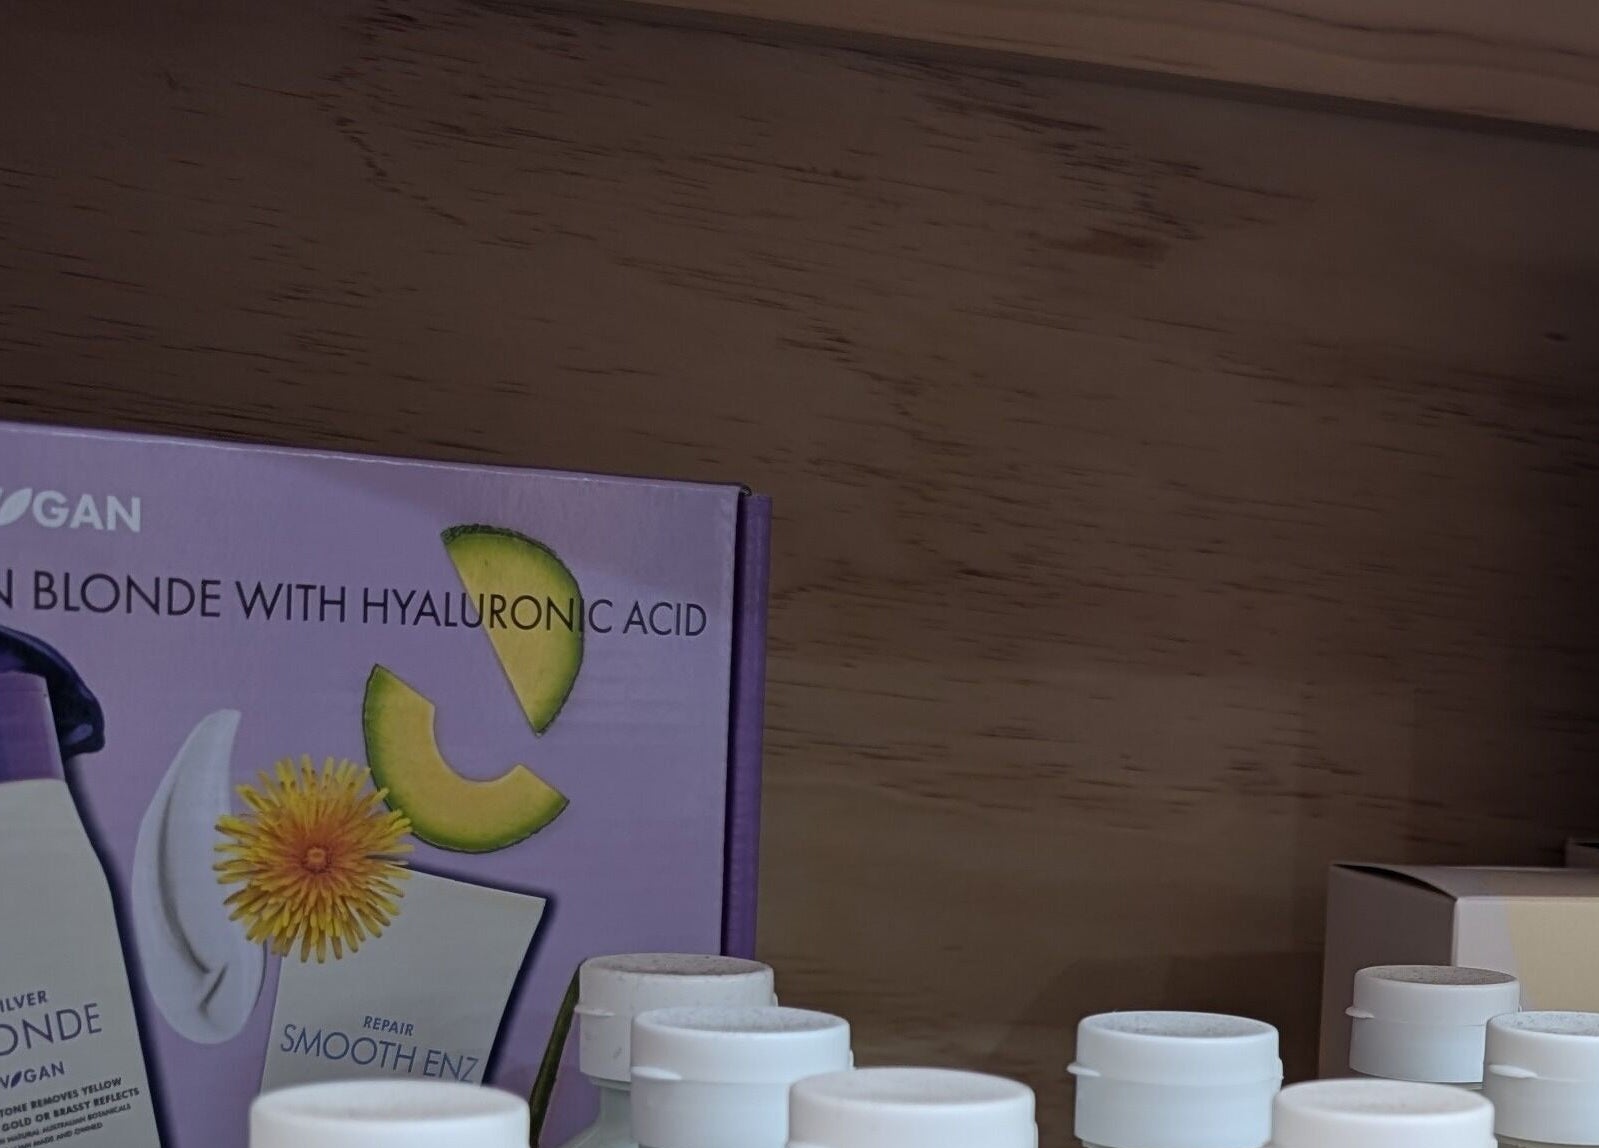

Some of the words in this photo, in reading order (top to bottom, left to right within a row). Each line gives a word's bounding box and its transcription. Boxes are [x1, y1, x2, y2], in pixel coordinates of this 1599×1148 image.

[33, 569, 221, 618] BLONDE
[235, 580, 346, 623] WITH
[361, 587, 613, 633] HYALURONIC
[623, 600, 707, 636] ACID
[0, 990, 48, 1013] ILVER
[363, 1015, 414, 1036] REPAIR
[280, 1024, 417, 1073] SMOOTH
[423, 1050, 479, 1082] ENZ
[2, 1117, 32, 1132] GOLD
[36, 1112, 50, 1122] OR
[53, 1101, 90, 1118] BRASSY
[93, 1088, 139, 1106] REFLECTS
[31, 1089, 79, 1109] REMOVES
[82, 1078, 122, 1096] YELLOW
